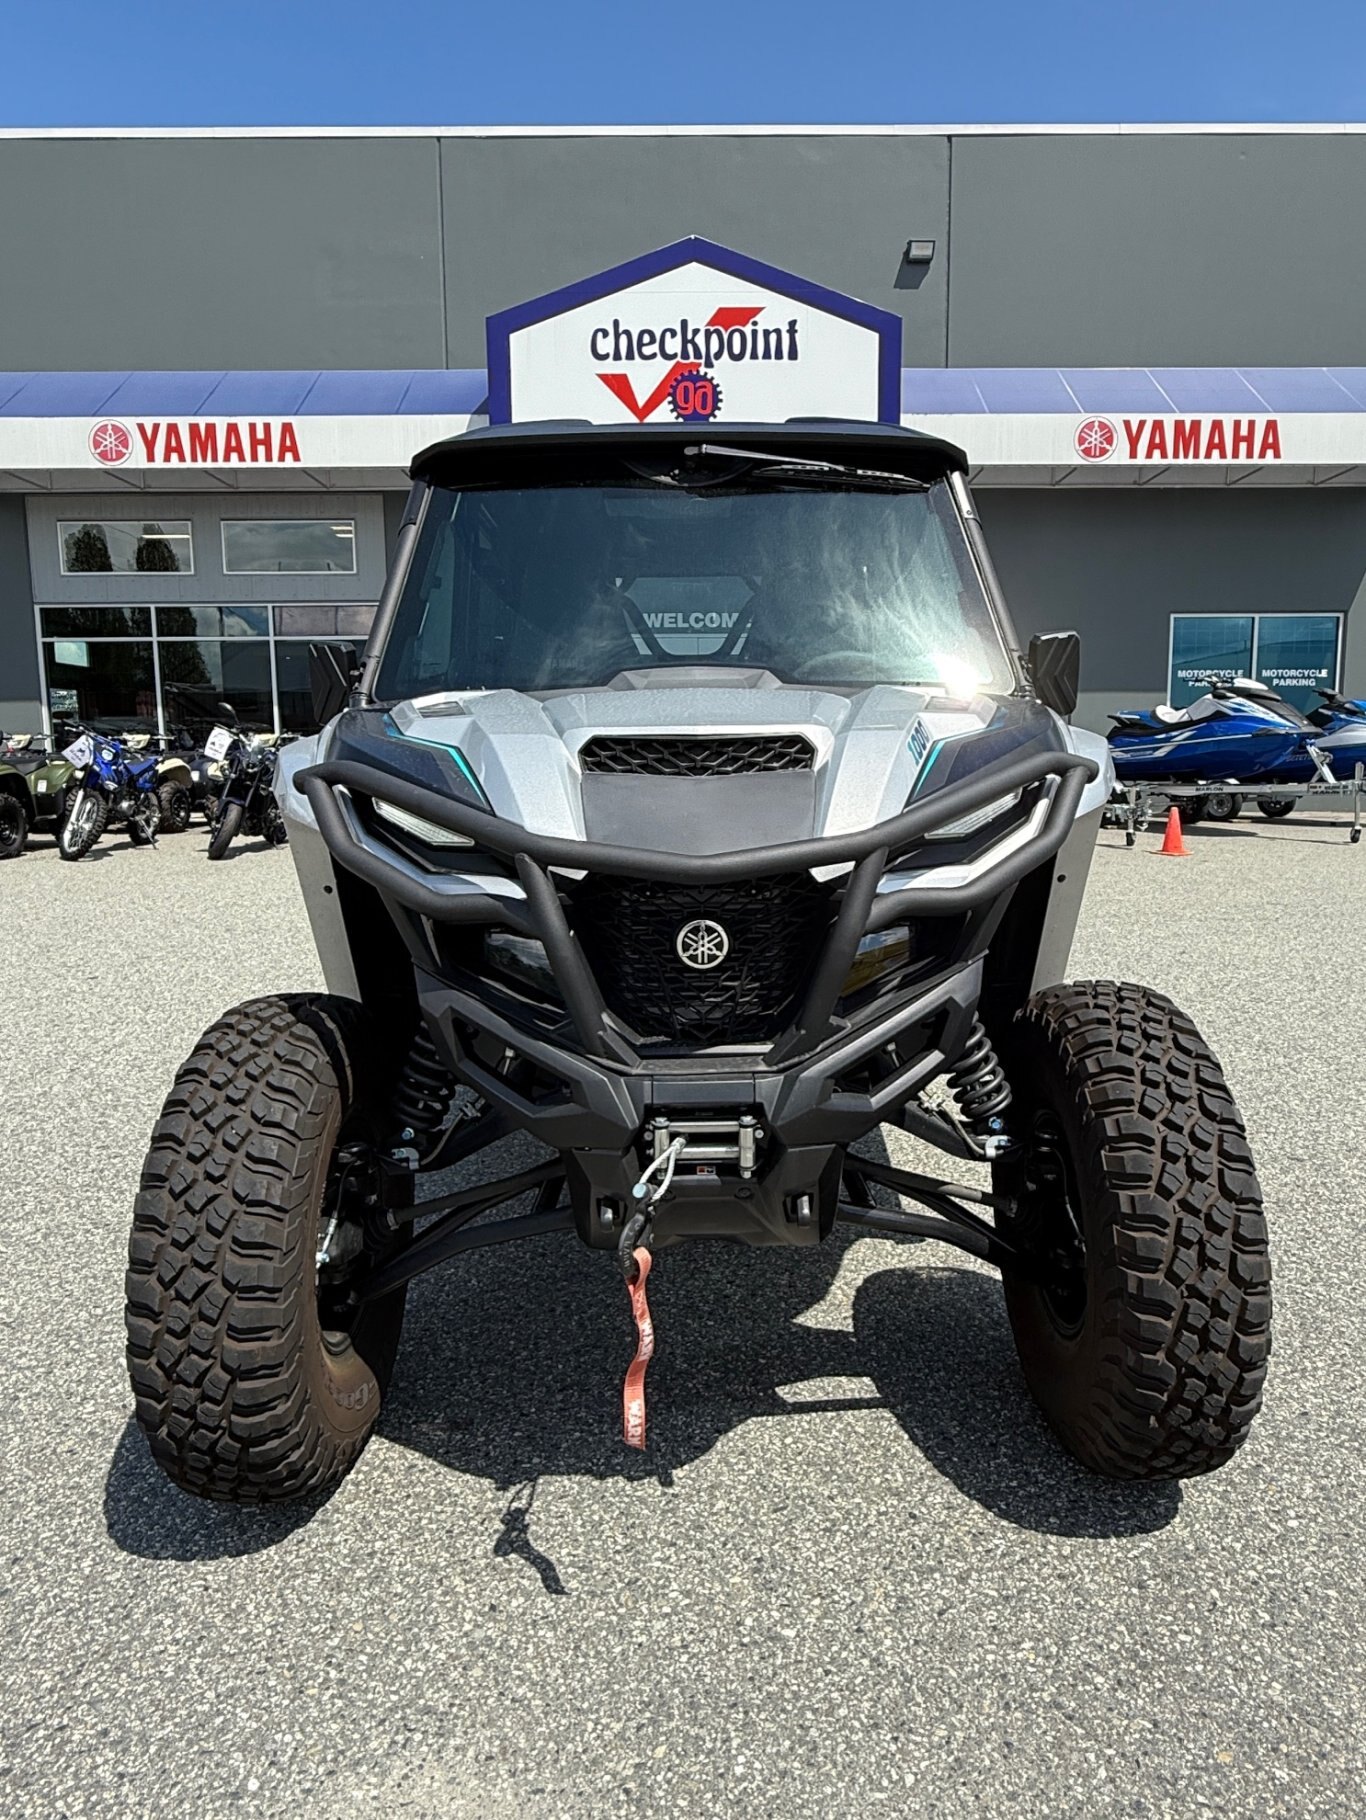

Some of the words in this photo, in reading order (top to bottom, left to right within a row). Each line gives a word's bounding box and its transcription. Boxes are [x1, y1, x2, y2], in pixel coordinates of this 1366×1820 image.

[591, 318, 798, 368] checkpoint
[136, 422, 302, 463] YAMAHA
[1123, 419, 1282, 460] YAMAHA
[643, 612, 752, 628] WELCOM
[1262, 669, 1329, 678] MOTORCYCLE
[1272, 678, 1317, 687] PARKING
[907, 719, 931, 767] 1000
